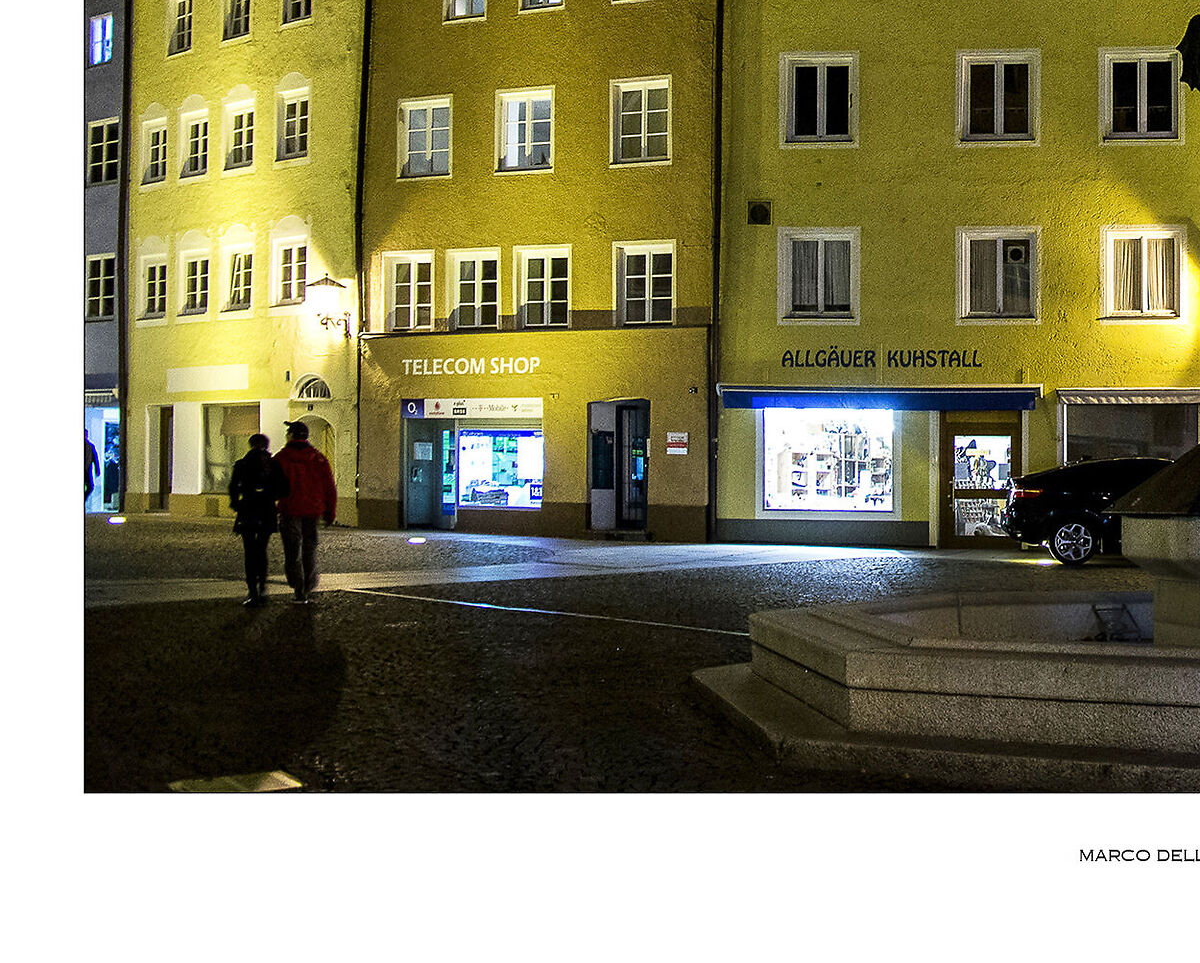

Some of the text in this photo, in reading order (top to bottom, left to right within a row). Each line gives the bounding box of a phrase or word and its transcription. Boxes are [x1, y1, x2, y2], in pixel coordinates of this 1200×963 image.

[401, 356, 541, 376] TELECOM SHOP
[781, 345, 983, 368] ALLGÄUER KUHSTALL
